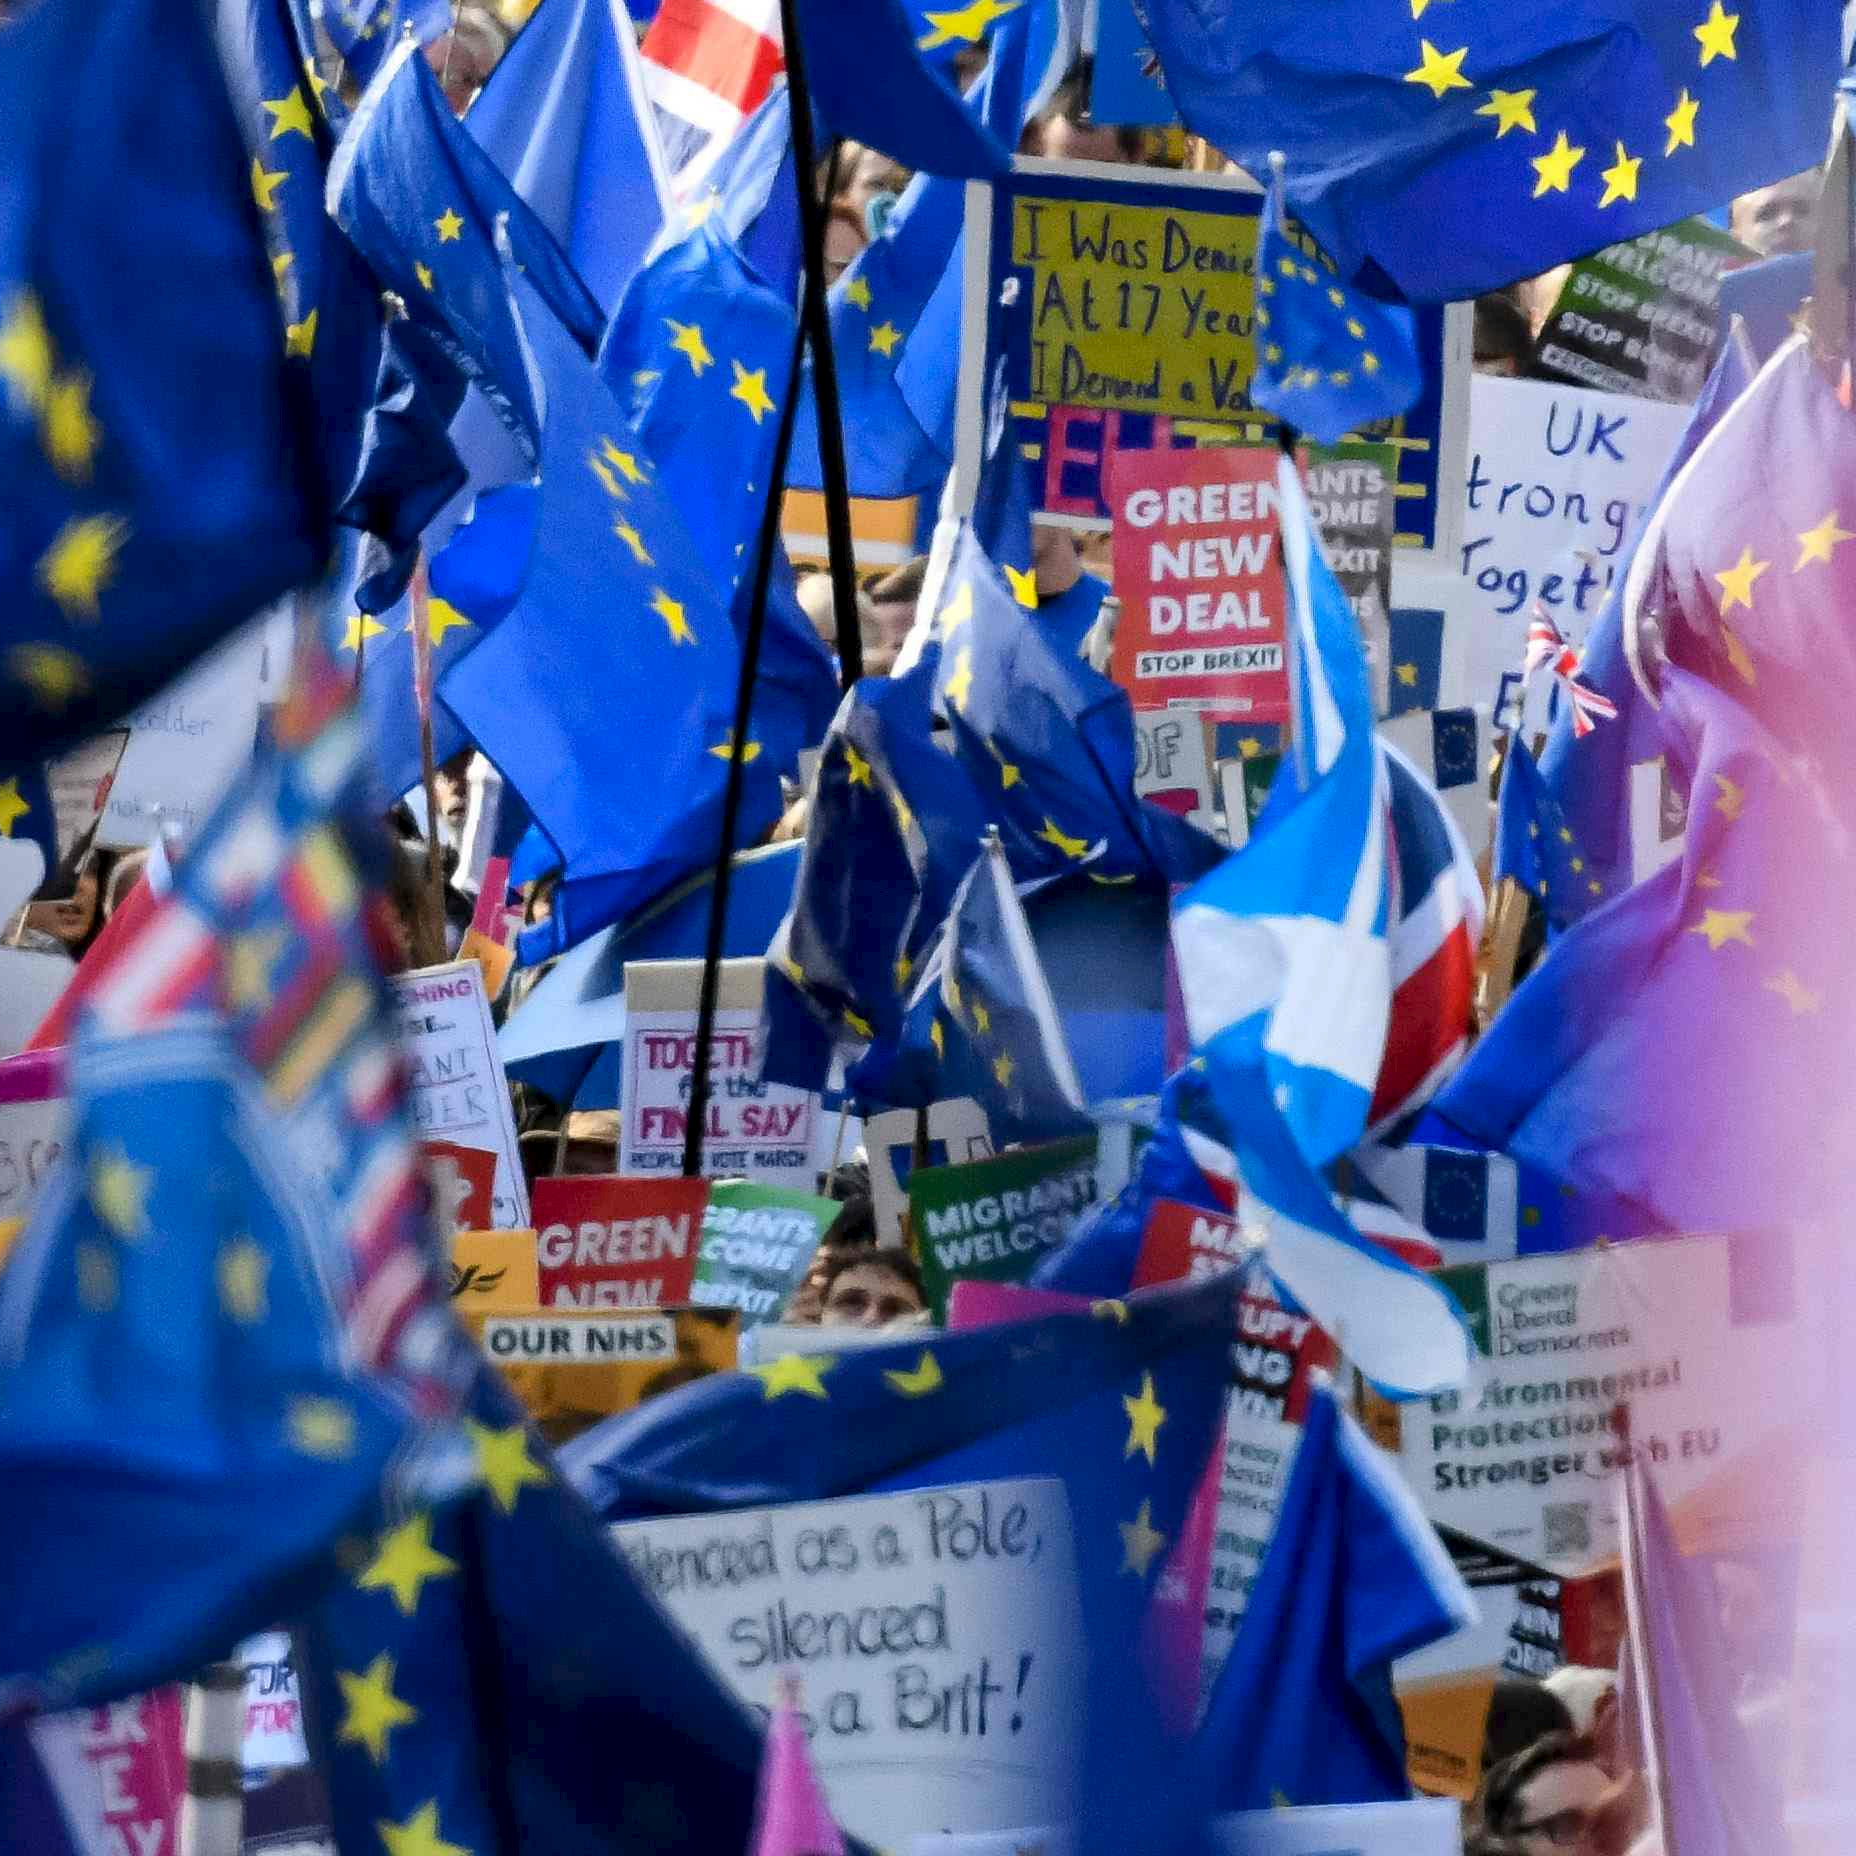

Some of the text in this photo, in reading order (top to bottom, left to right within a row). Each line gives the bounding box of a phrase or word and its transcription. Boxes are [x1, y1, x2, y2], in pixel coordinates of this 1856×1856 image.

[1021, 205, 1048, 263] I
[1069, 210, 1148, 273] Was
[1038, 279, 1100, 334] At
[1115, 283, 1160, 330] 17
[1547, 401, 1629, 460] UK
[1125, 479, 1284, 528] GREEN
[1148, 533, 1272, 583] NEW
[1148, 588, 1271, 636] DEAL
[1139, 644, 1280, 676] STOP BREXIT
[640, 1100, 805, 1142] FINL SAY
[536, 1212, 693, 1270] GREEN
[552, 1277, 671, 1309] NEW
[489, 1318, 669, 1355] OUR NHS
[1428, 1356, 1684, 1416] Eironmental
[1433, 1448, 1596, 1494] Stronger
[794, 1520, 860, 1578] as
[874, 1527, 910, 1566] a
[917, 1490, 1044, 1568] Pole,
[727, 1582, 953, 1672] silenced
[832, 1695, 866, 1738] a
